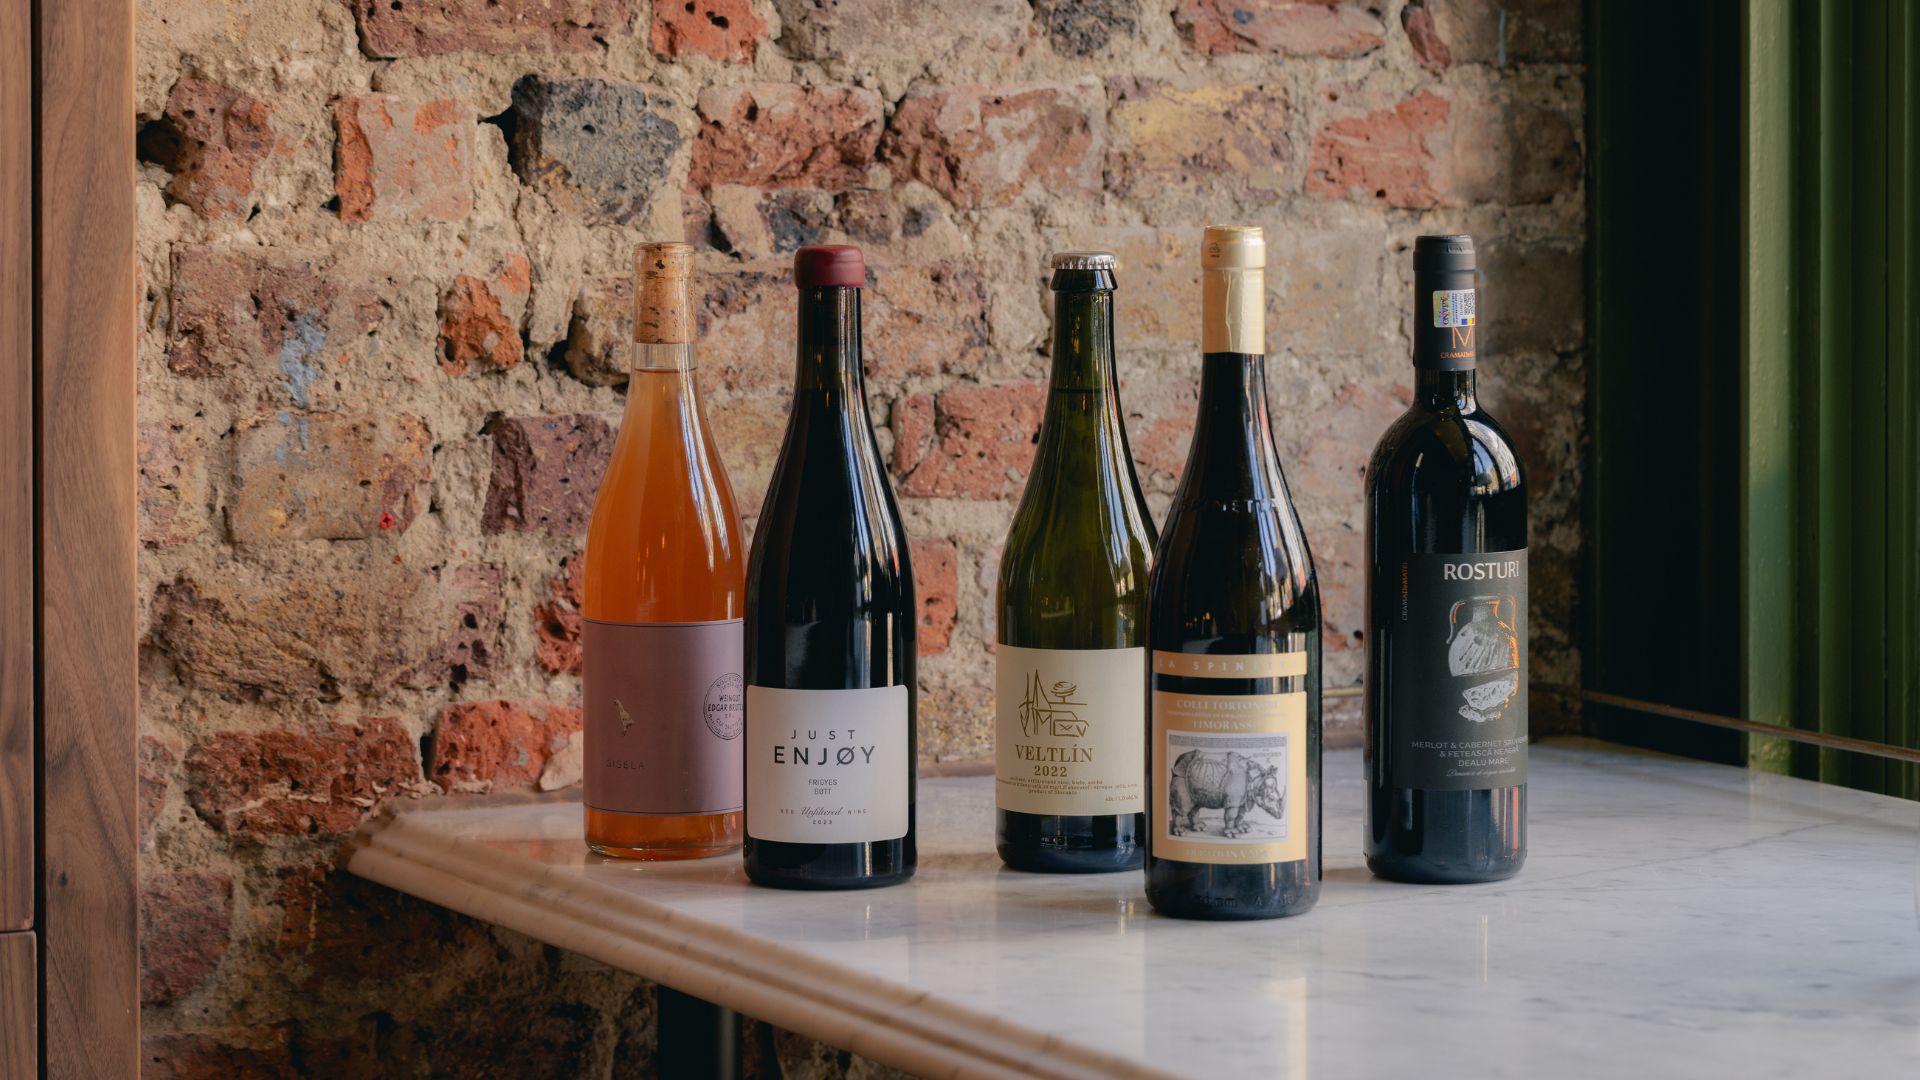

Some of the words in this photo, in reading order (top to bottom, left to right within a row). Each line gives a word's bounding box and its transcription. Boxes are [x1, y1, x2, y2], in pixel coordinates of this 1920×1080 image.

[1443, 560, 1520, 581] ROSTURI
[707, 703, 728, 712] EDGAR
[791, 729, 857, 740] JUST
[1411, 741, 1448, 749] MERLOT
[1458, 740, 1502, 749] CABERNET
[773, 745, 876, 767] ENJØY
[1015, 744, 1093, 763] VELTLÍN
[1458, 759, 1487, 767] DEALU
[1488, 757, 1510, 766] MARE
[1034, 765, 1068, 778] 2022
[808, 778, 838, 786] FRIGYES
[800, 806, 843, 819] Unfiltered
